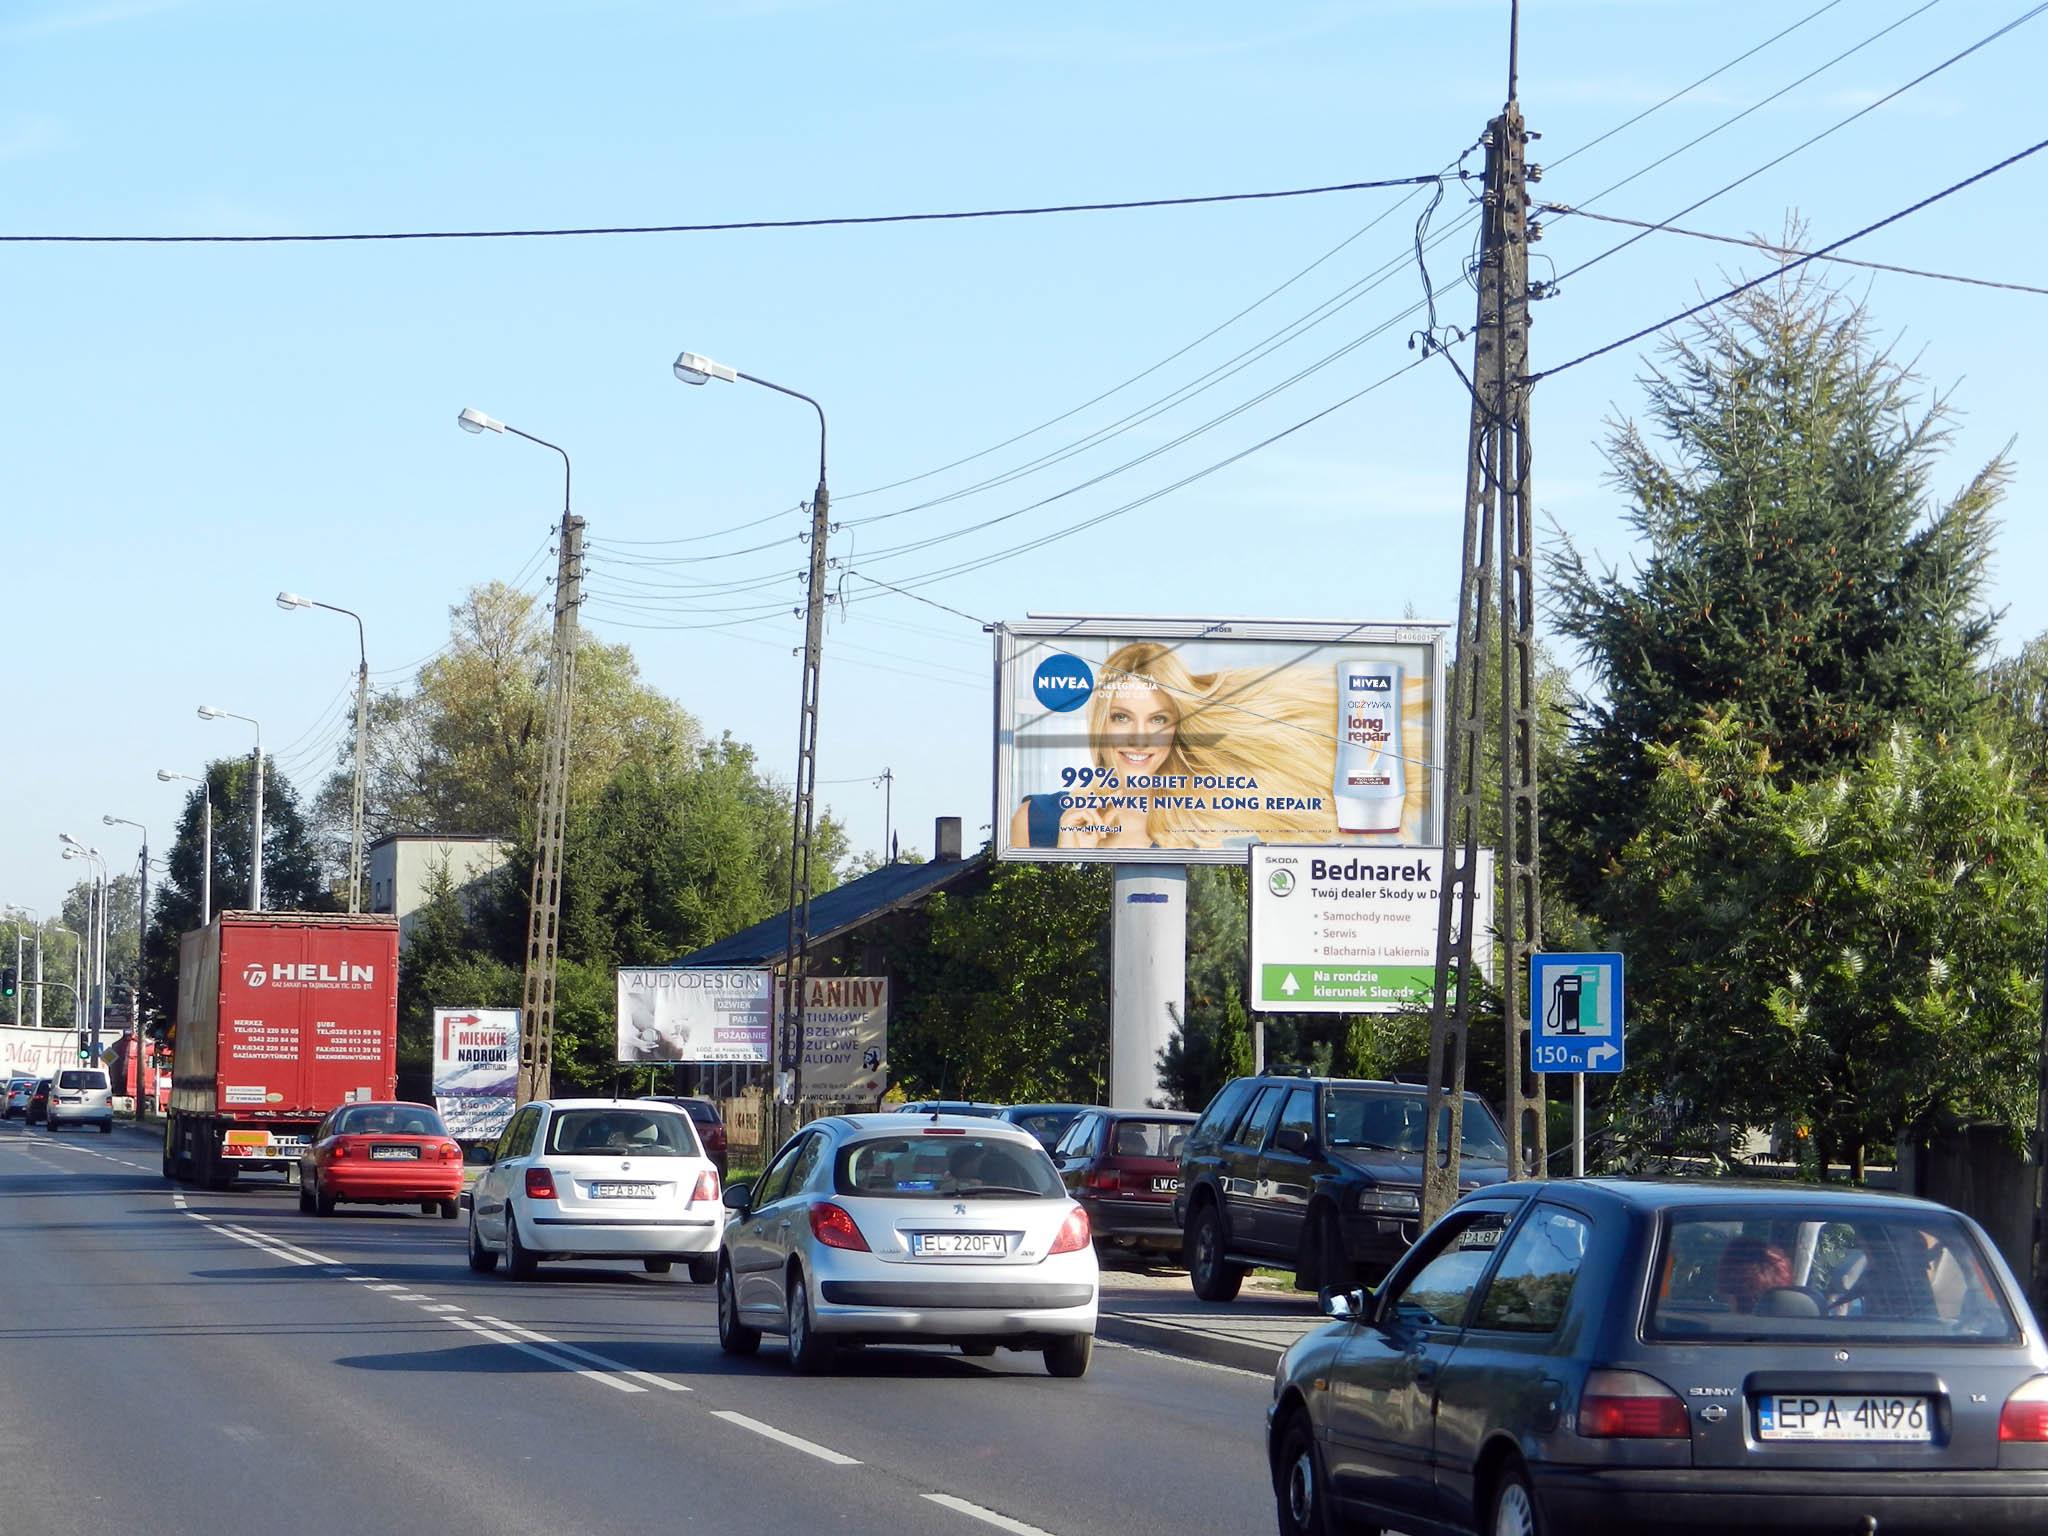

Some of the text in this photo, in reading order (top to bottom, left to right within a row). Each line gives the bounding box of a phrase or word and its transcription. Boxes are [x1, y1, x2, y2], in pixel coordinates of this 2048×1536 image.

[1038, 676, 1090, 689] NIVEA
[1352, 678, 1388, 688] NIVEA
[1347, 714, 1383, 732] long
[1347, 730, 1391, 744] repair
[1060, 767, 1258, 789] 99% KOBIET POLECA
[1060, 791, 1148, 812] ODŻYWKĘ
[1154, 797, 1206, 809] NIVEA
[1212, 797, 1259, 810] LONG
[1060, 825, 1122, 833] www.NIVEA.pl
[1311, 859, 1432, 882] Bednarek
[1311, 887, 1338, 900] Twój
[1341, 887, 1375, 899] dealer
[1379, 886, 1414, 902] Škody
[1417, 891, 1426, 899] w
[1323, 911, 1412, 925] Samochody nowe
[1323, 928, 1357, 939] Serwis
[1323, 946, 1376, 957] Blacharnia
[1384, 946, 1430, 957] Lakiernia
[272, 961, 374, 982] HELİN
[1313, 970, 1378, 983] Na rondzie
[1313, 985, 1367, 998] kierunek
[459, 1031, 508, 1047] MIĘKKIE
[458, 1049, 508, 1062] NADRUKI
[1536, 1046, 1583, 1064] 150 m
[600, 1184, 656, 1196] EPA 87RN
[924, 1235, 1002, 1251] EL 220FV
[1689, 1387, 1737, 1396] SUNNY
[1778, 1398, 1923, 1429] EPA 4N96
